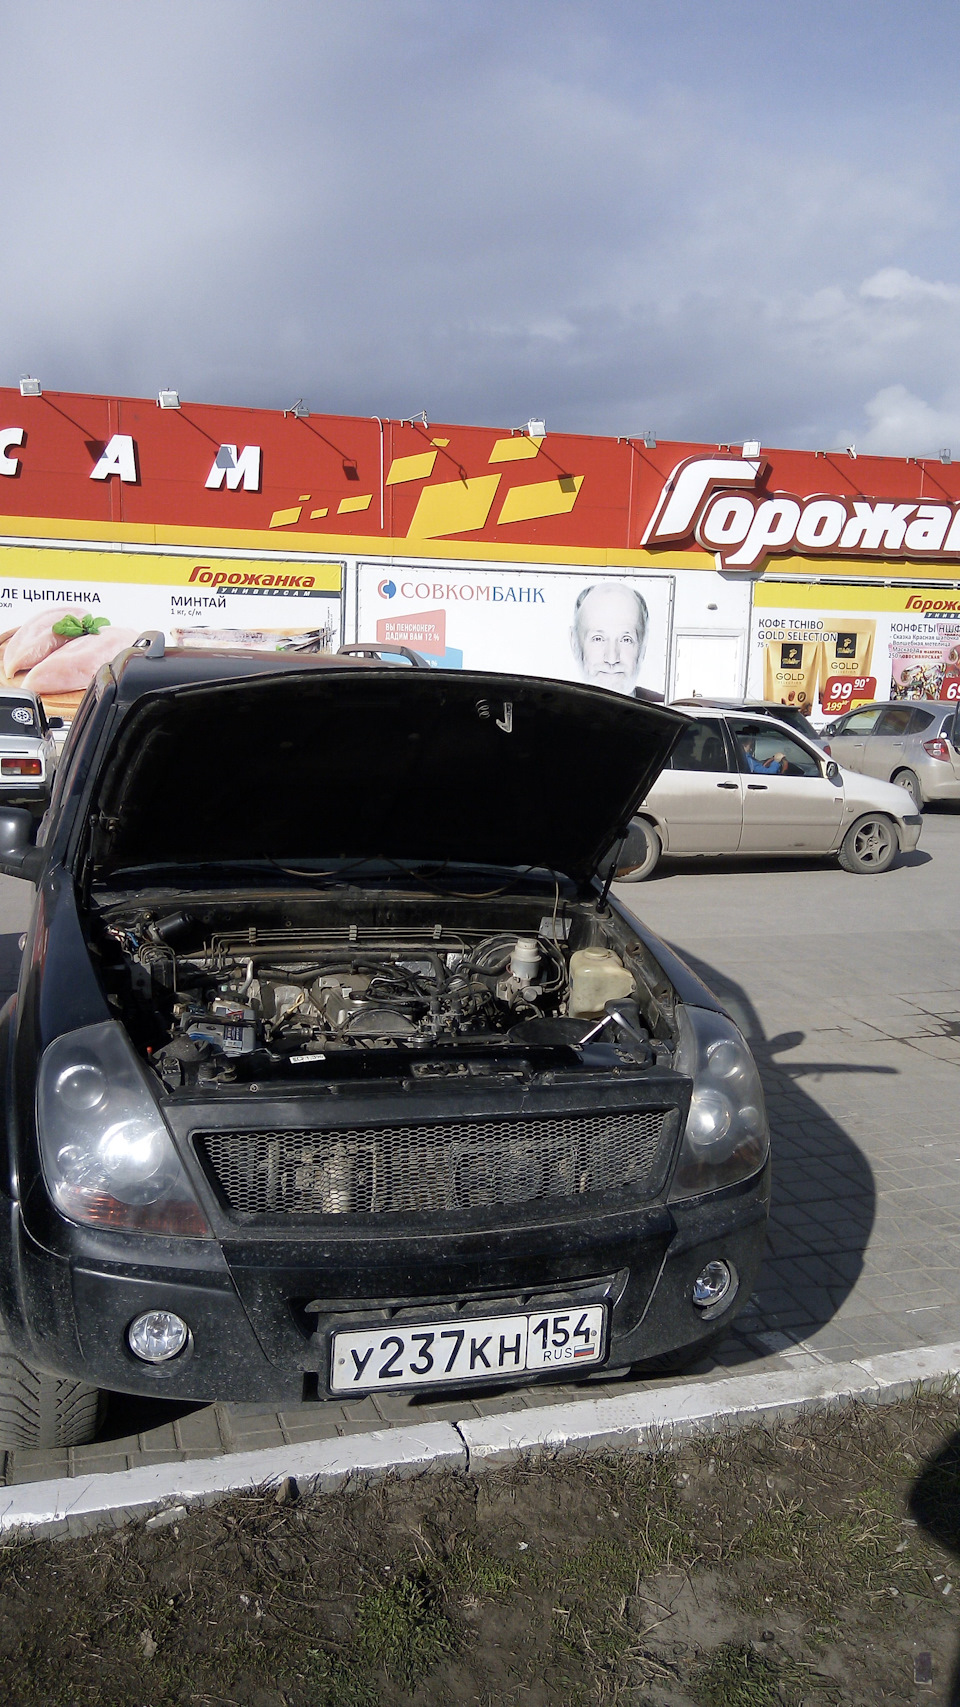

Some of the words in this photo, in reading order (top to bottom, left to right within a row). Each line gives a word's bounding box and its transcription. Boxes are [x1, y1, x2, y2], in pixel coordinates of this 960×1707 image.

[188, 566, 315, 588] Горожанка
[23, 589, 101, 603] ЦЫПЛЕНКА
[220, 587, 311, 597] УНИВЕРСАМ
[401, 582, 546, 603] СОВКОМБАНК
[171, 595, 226, 608] МИНТАЙ
[905, 595, 960, 612] Горож
[385, 623, 396, 631] ВЫ
[397, 623, 436, 633] ПЕНСИОНЕР?
[758, 618, 787, 628] КОФЕ
[788, 619, 824, 630] TCHIBO
[890, 623, 936, 633] КОНФЕТЫ
[385, 632, 409, 641] ДАДИМ
[409, 633, 423, 641] ВАМ
[757, 630, 785, 640] GOLD
[787, 631, 838, 642] SELECTION
[831, 662, 859, 670] GOLD
[776, 673, 805, 681] GOLD
[830, 682, 853, 700] 99
[350, 1329, 521, 1381] У237КН
[532, 1313, 591, 1349] 154
[543, 1347, 573, 1362] RUS
